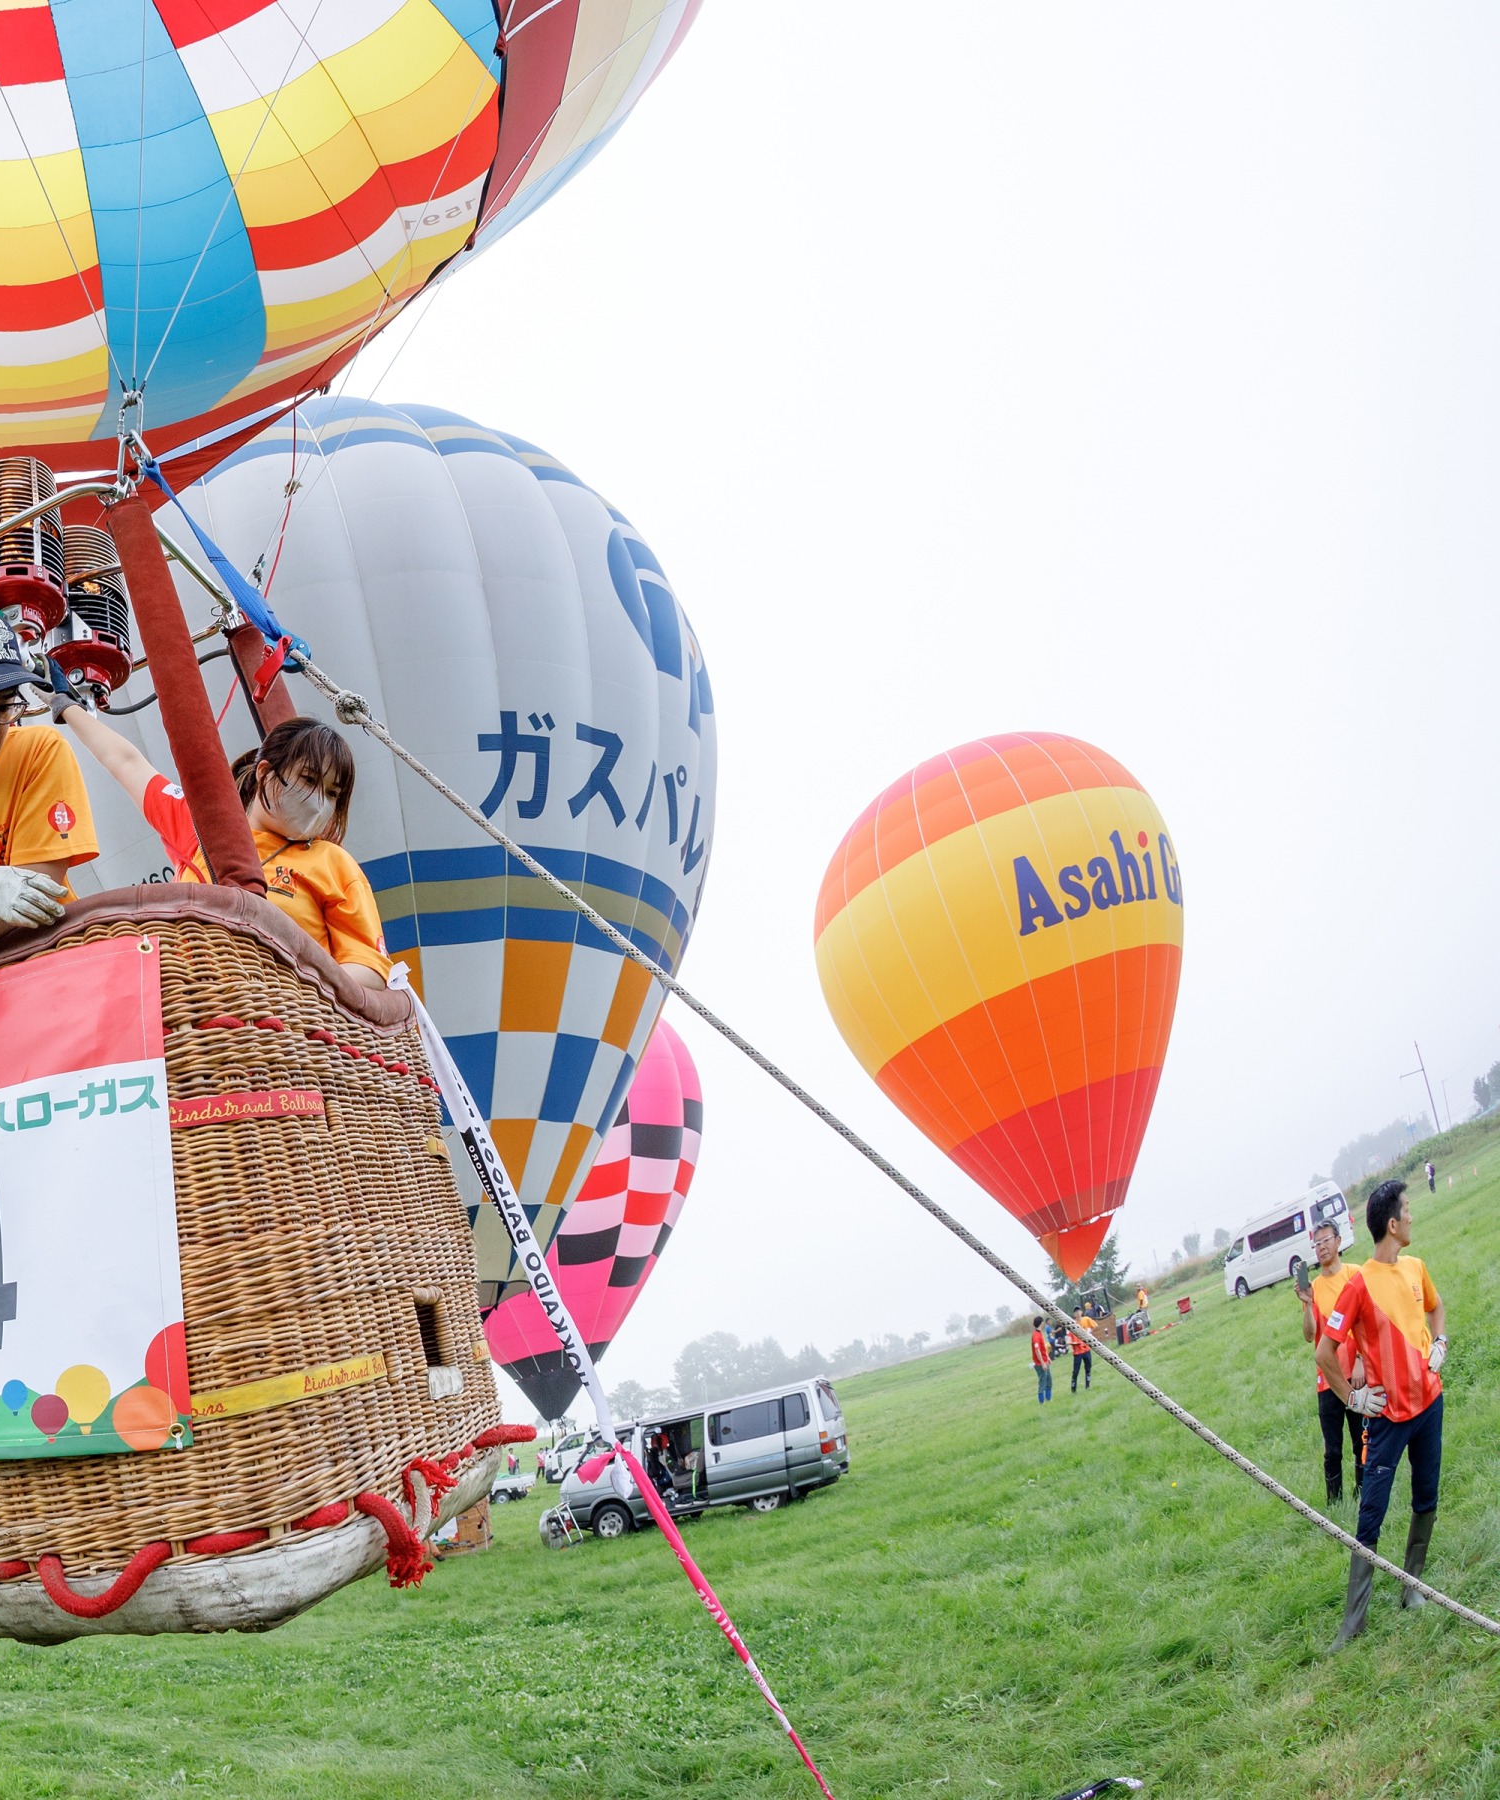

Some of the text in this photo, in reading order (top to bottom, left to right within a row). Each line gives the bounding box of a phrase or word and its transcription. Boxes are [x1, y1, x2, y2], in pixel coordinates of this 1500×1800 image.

[54, 811, 71, 825] 51
[1013, 829, 1184, 936] Asahi G
